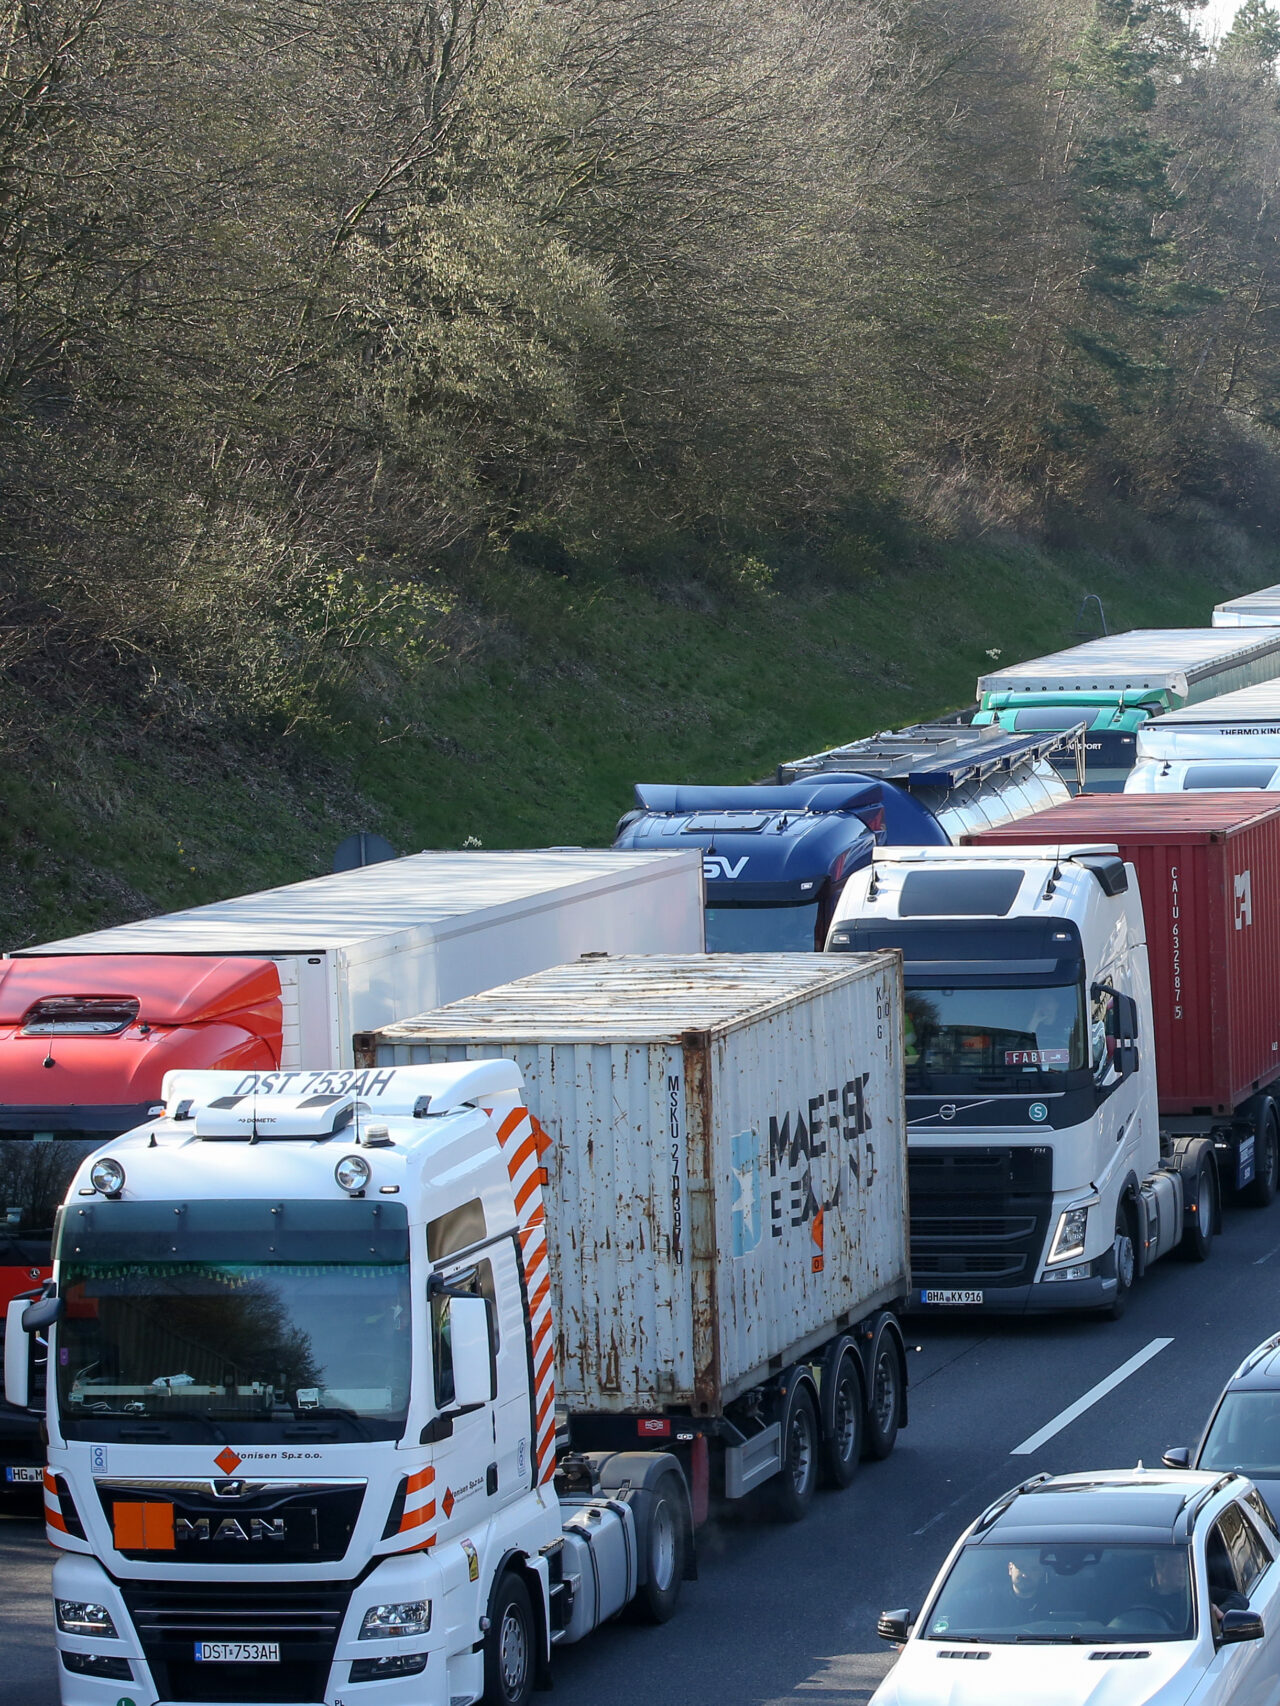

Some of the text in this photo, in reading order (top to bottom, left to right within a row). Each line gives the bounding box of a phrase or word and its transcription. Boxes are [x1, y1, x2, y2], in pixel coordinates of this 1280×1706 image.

[233, 1070, 396, 1096] DST 753AH
[668, 1076, 680, 1138] MSKU
[1034, 1107, 1042, 1118] S
[951, 1292, 962, 1301] KX
[965, 1292, 981, 1301] 916
[13, 1469, 28, 1480] HG
[176, 1518, 284, 1541] MAN
[203, 1645, 278, 1660] DST 753AH
